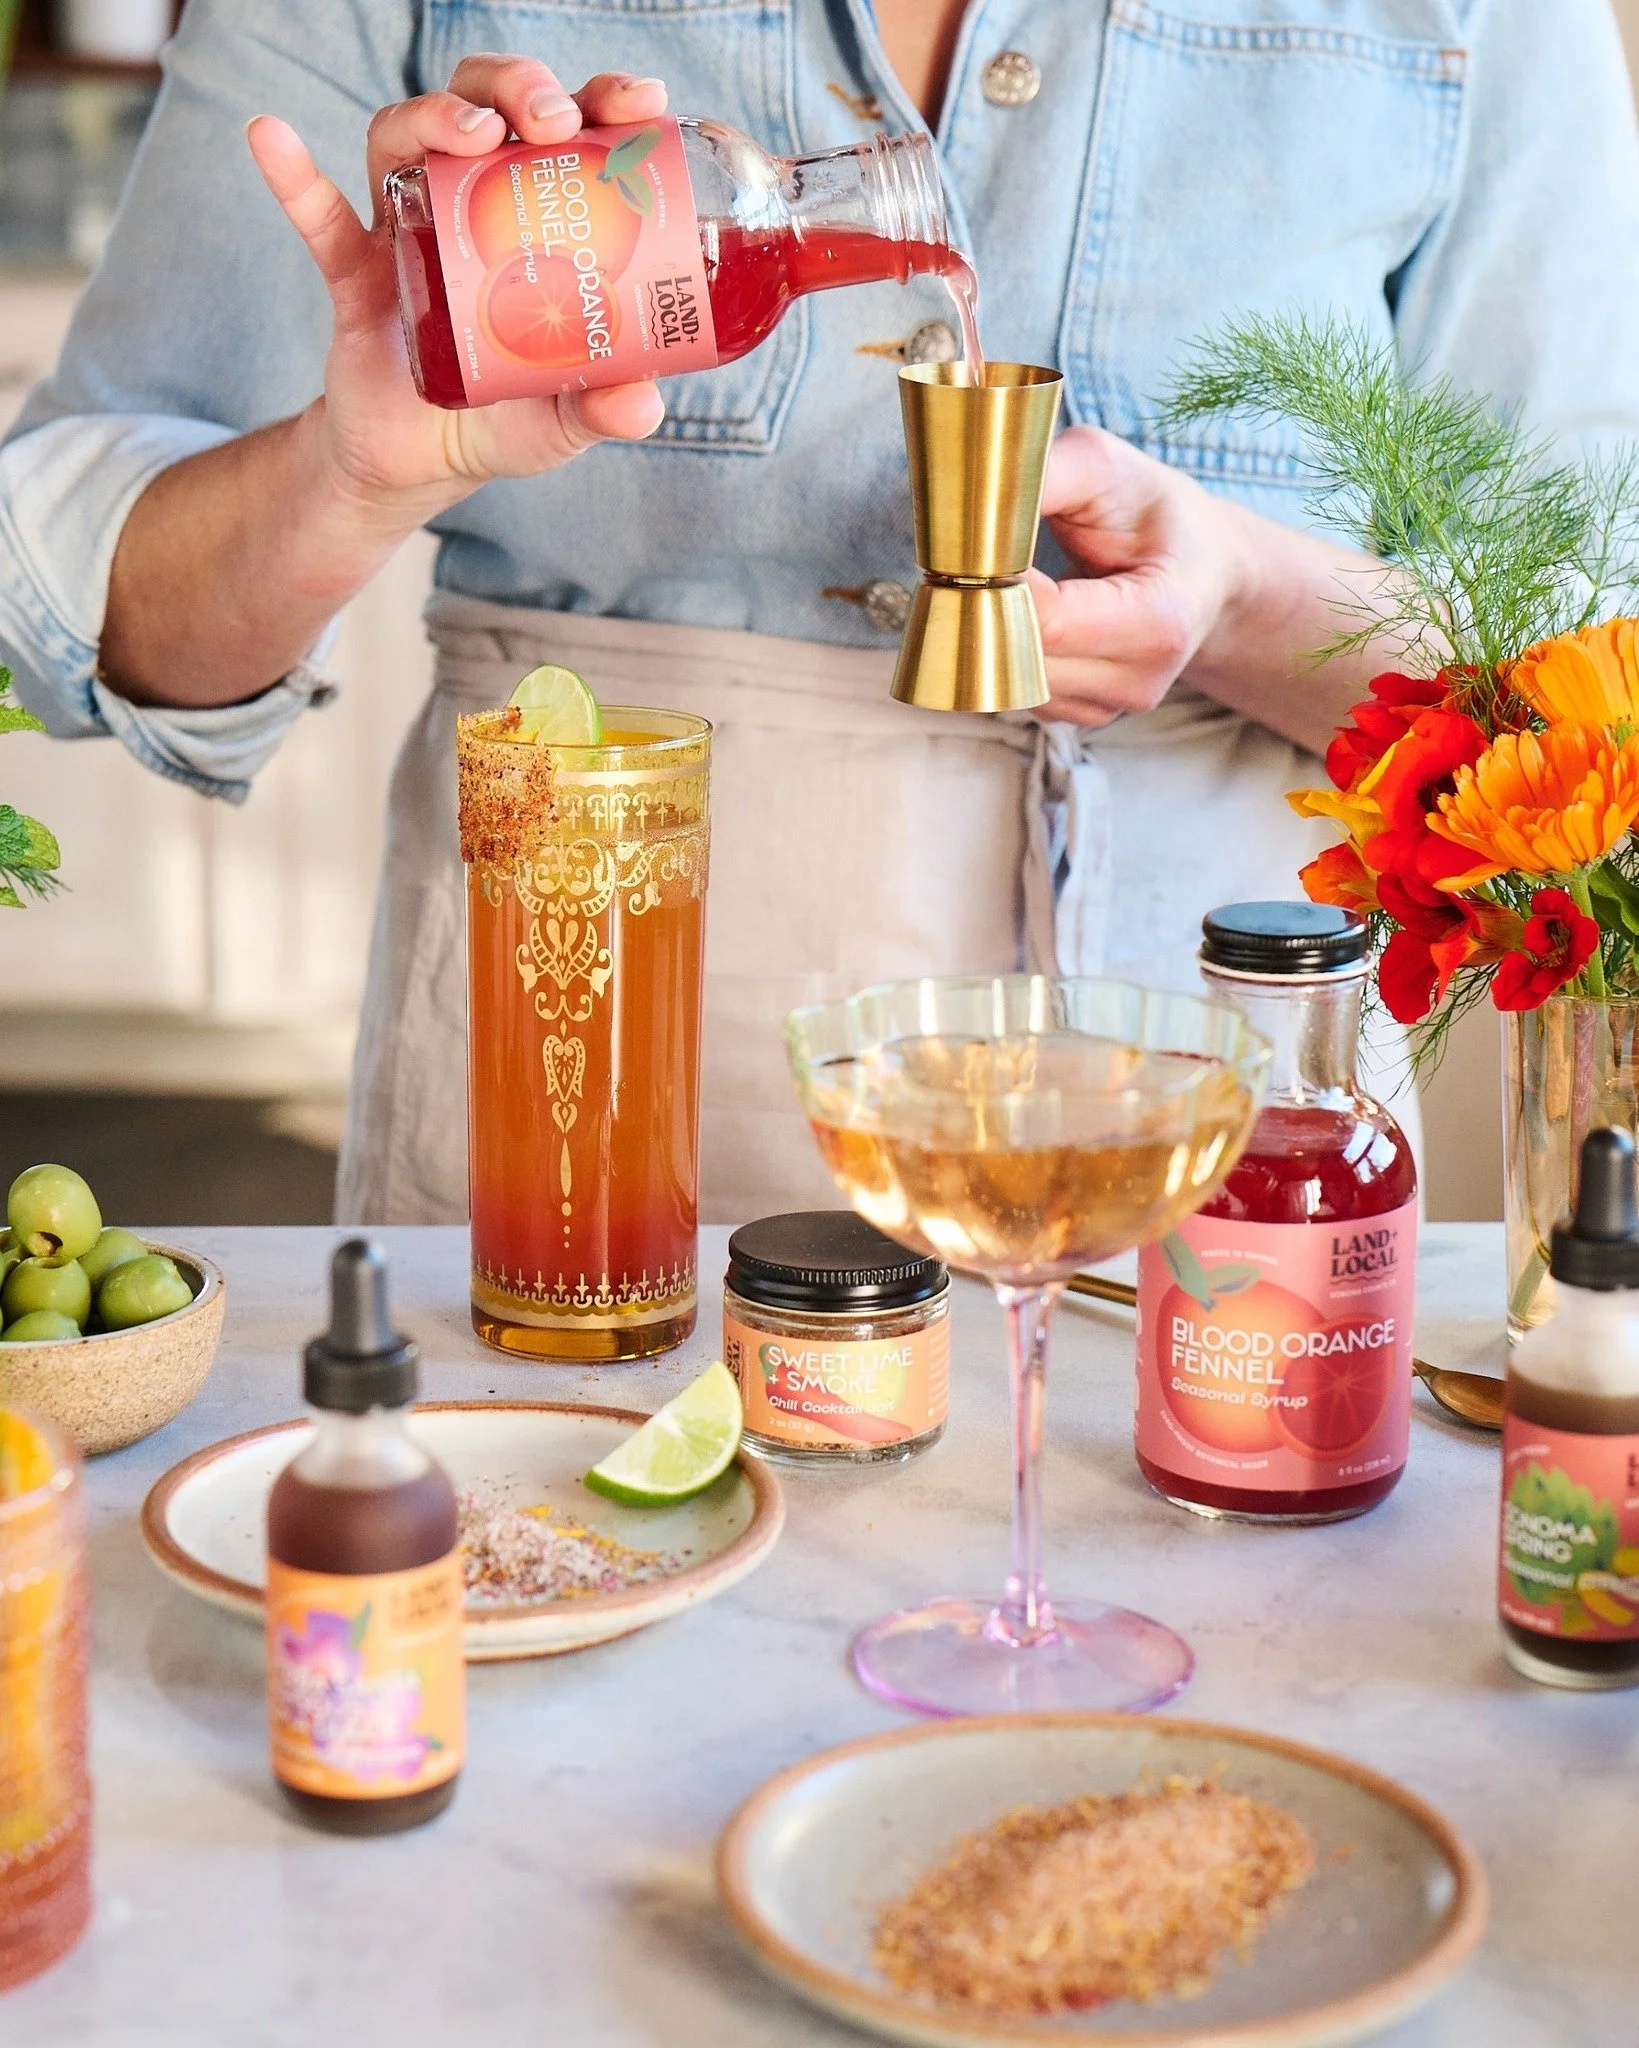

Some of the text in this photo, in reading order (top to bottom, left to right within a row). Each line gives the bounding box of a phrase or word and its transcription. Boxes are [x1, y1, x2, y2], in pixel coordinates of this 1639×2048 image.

[509, 162, 539, 284] Seasonal Syrup
[530, 156, 568, 258] FENNEL
[556, 153, 613, 361] BLOOD ORANGE
[654, 277, 682, 349] LOCAL
[674, 275, 700, 344] LAND+
[1330, 1246, 1398, 1278] LOCAL
[1331, 1229, 1398, 1256] LAND+
[1171, 1316, 1396, 1359] BLOOD ORANGE
[768, 1346, 914, 1374] SWEET LIME
[1171, 1343, 1284, 1386] FENNEL
[768, 1370, 878, 1395] + SMOKE
[1170, 1376, 1309, 1410] Seasonal Syrup
[801, 1400, 861, 1415] Cocktail
